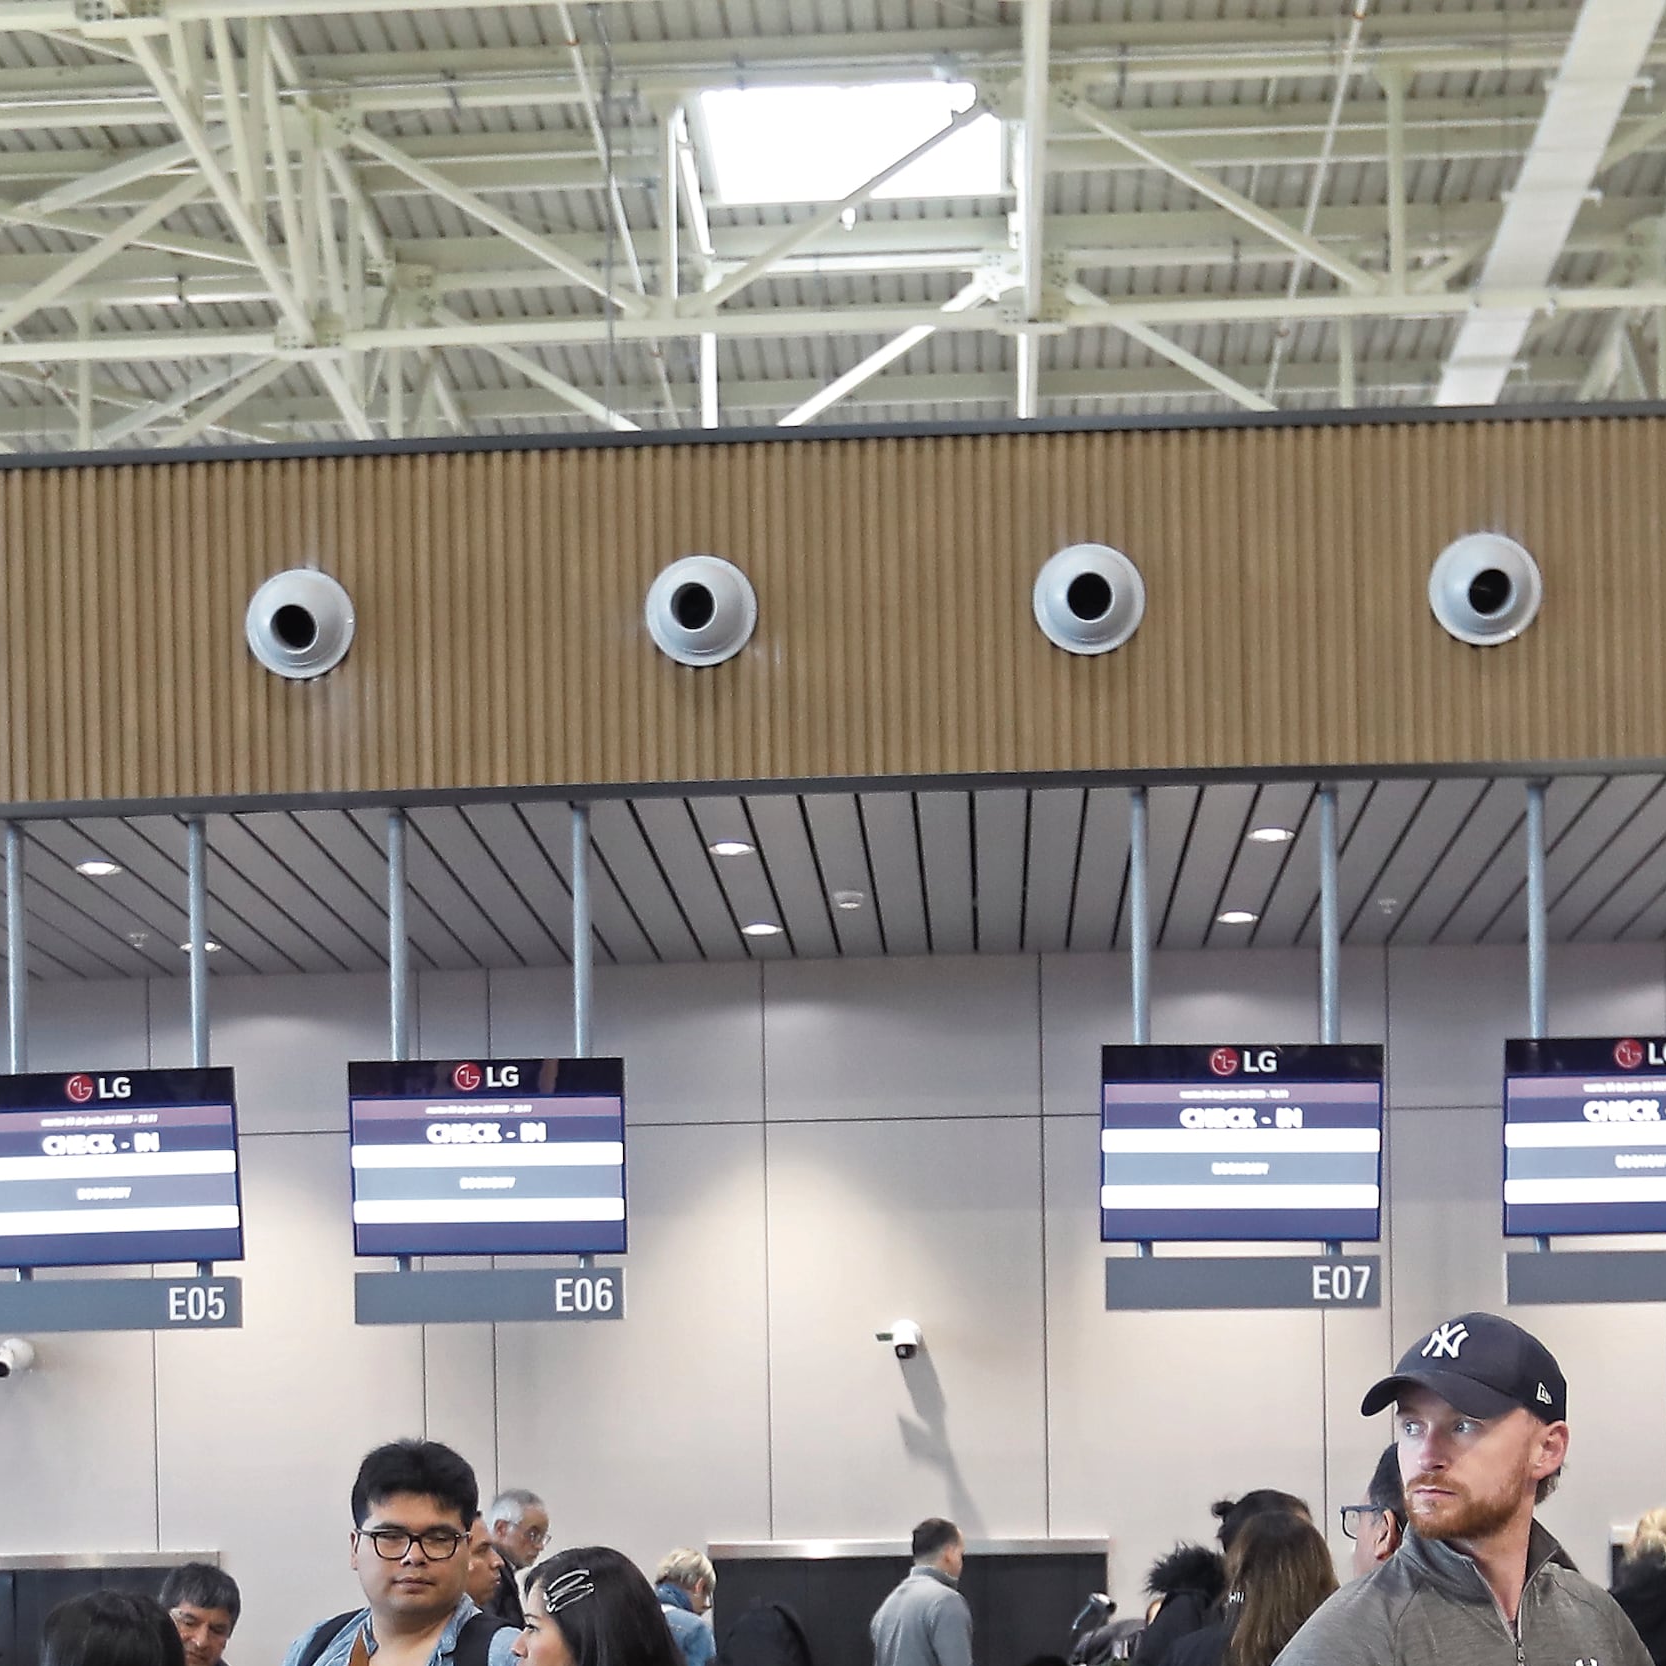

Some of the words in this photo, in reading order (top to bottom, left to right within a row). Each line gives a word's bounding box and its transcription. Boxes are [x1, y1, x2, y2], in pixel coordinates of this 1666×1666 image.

[1243, 1050, 1277, 1073] LG
[98, 1077, 131, 1099] LG
[486, 1065, 519, 1088] LG
[555, 1277, 614, 1313] E06
[1312, 1265, 1371, 1300] E07
[169, 1286, 226, 1321] E05
